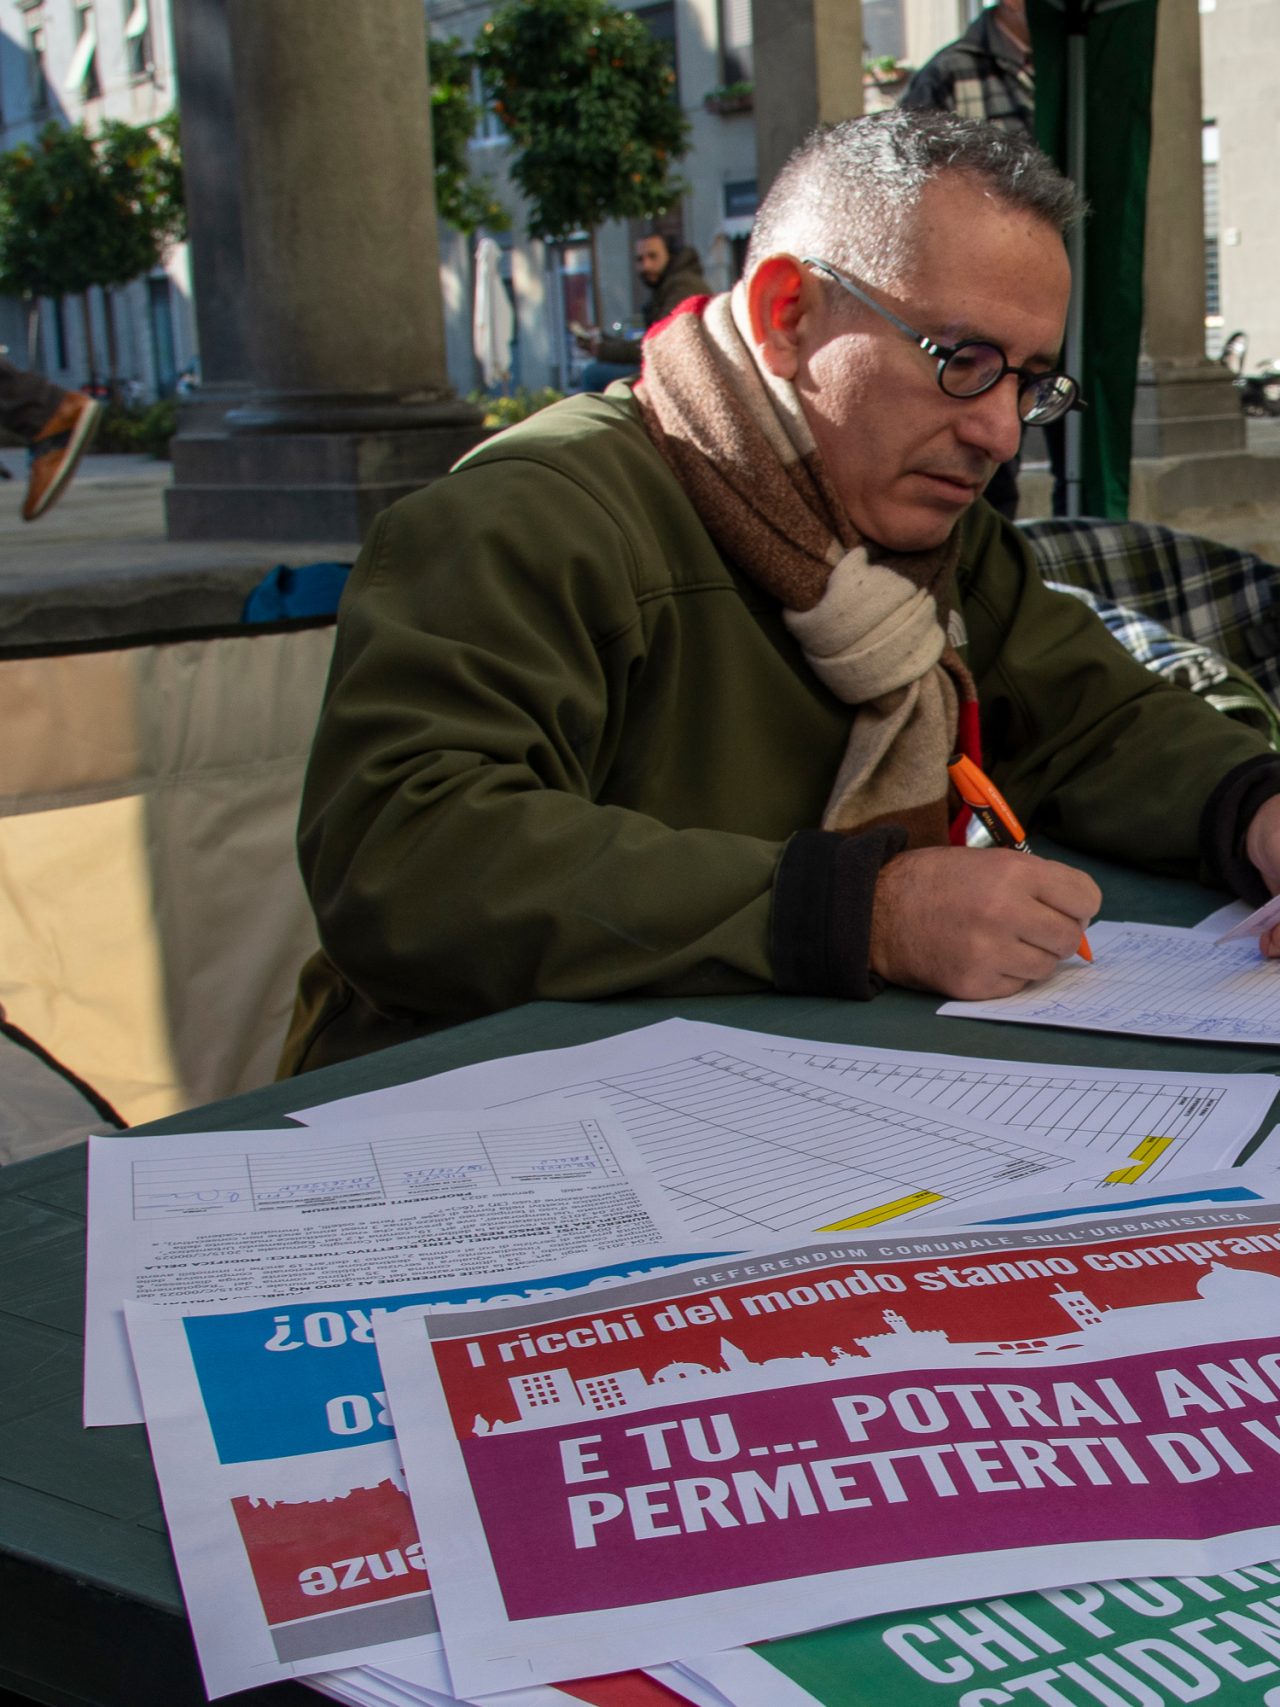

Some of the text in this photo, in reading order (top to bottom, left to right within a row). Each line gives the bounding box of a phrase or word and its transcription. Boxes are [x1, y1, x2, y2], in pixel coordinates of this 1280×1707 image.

[390, 1192, 472, 1204] PROPONENTI
[543, 1188, 633, 1202] nell'articolazione
[301, 1201, 386, 1214] REFERENDUM
[458, 1209, 526, 1219] temporaneo
[414, 1216, 455, 1224] utilizzo
[478, 1216, 557, 1227] limitatamente
[507, 1211, 648, 1233] DISCIPLINA SENSO
[395, 1221, 442, 1231] previsto
[488, 1222, 537, 1231] revocata
[275, 1233, 337, 1241] costituisce
[396, 1229, 472, 1240] deliberazione
[467, 1230, 552, 1243] TEMPORANEI
[204, 1238, 272, 1247] mutamento
[318, 1238, 372, 1247] Consiglio
[512, 1238, 556, 1247] servizio
[548, 1236, 608, 1248] consentito
[257, 1243, 315, 1252] Comunale
[265, 1244, 418, 1261] RICETTIVO-TURISTICI:
[457, 1245, 540, 1257] l'insediamento
[539, 1243, 587, 1253] secondo
[693, 1248, 868, 1287] REFERENDUM
[878, 1236, 1011, 1258] COMUNALE
[1022, 1210, 1252, 1246] SULL'URBANISTICA
[190, 1257, 261, 1266] MODIFICA
[336, 1258, 411, 1268] destinazione
[506, 1257, 557, 1266] revocata
[177, 1268, 230, 1276] immobili
[262, 1265, 327, 1274] direzionale
[320, 1266, 370, 1274] pubblico
[410, 1264, 489, 1276] deliberazione
[175, 1271, 252, 1281] comprensiva
[261, 1271, 315, 1279] esistente
[330, 1273, 386, 1283] Consiglio
[377, 1273, 455, 1284] SUPERIORE
[150, 1278, 212, 1287] dismesso,
[266, 1279, 327, 1288] Comunale
[465, 1341, 486, 1369] I
[496, 1312, 645, 1363] ricchi
[652, 1300, 732, 1334] del
[739, 1268, 910, 1320] mondo
[912, 1254, 1079, 1294] stanno
[558, 1434, 609, 1485] E
[624, 1412, 820, 1471] TU...
[831, 1378, 1143, 1443] POTRAI
[566, 1436, 1151, 1550] PERMETTERTI
[1145, 1426, 1254, 1485] DI
[881, 1594, 1067, 1687] CHI
